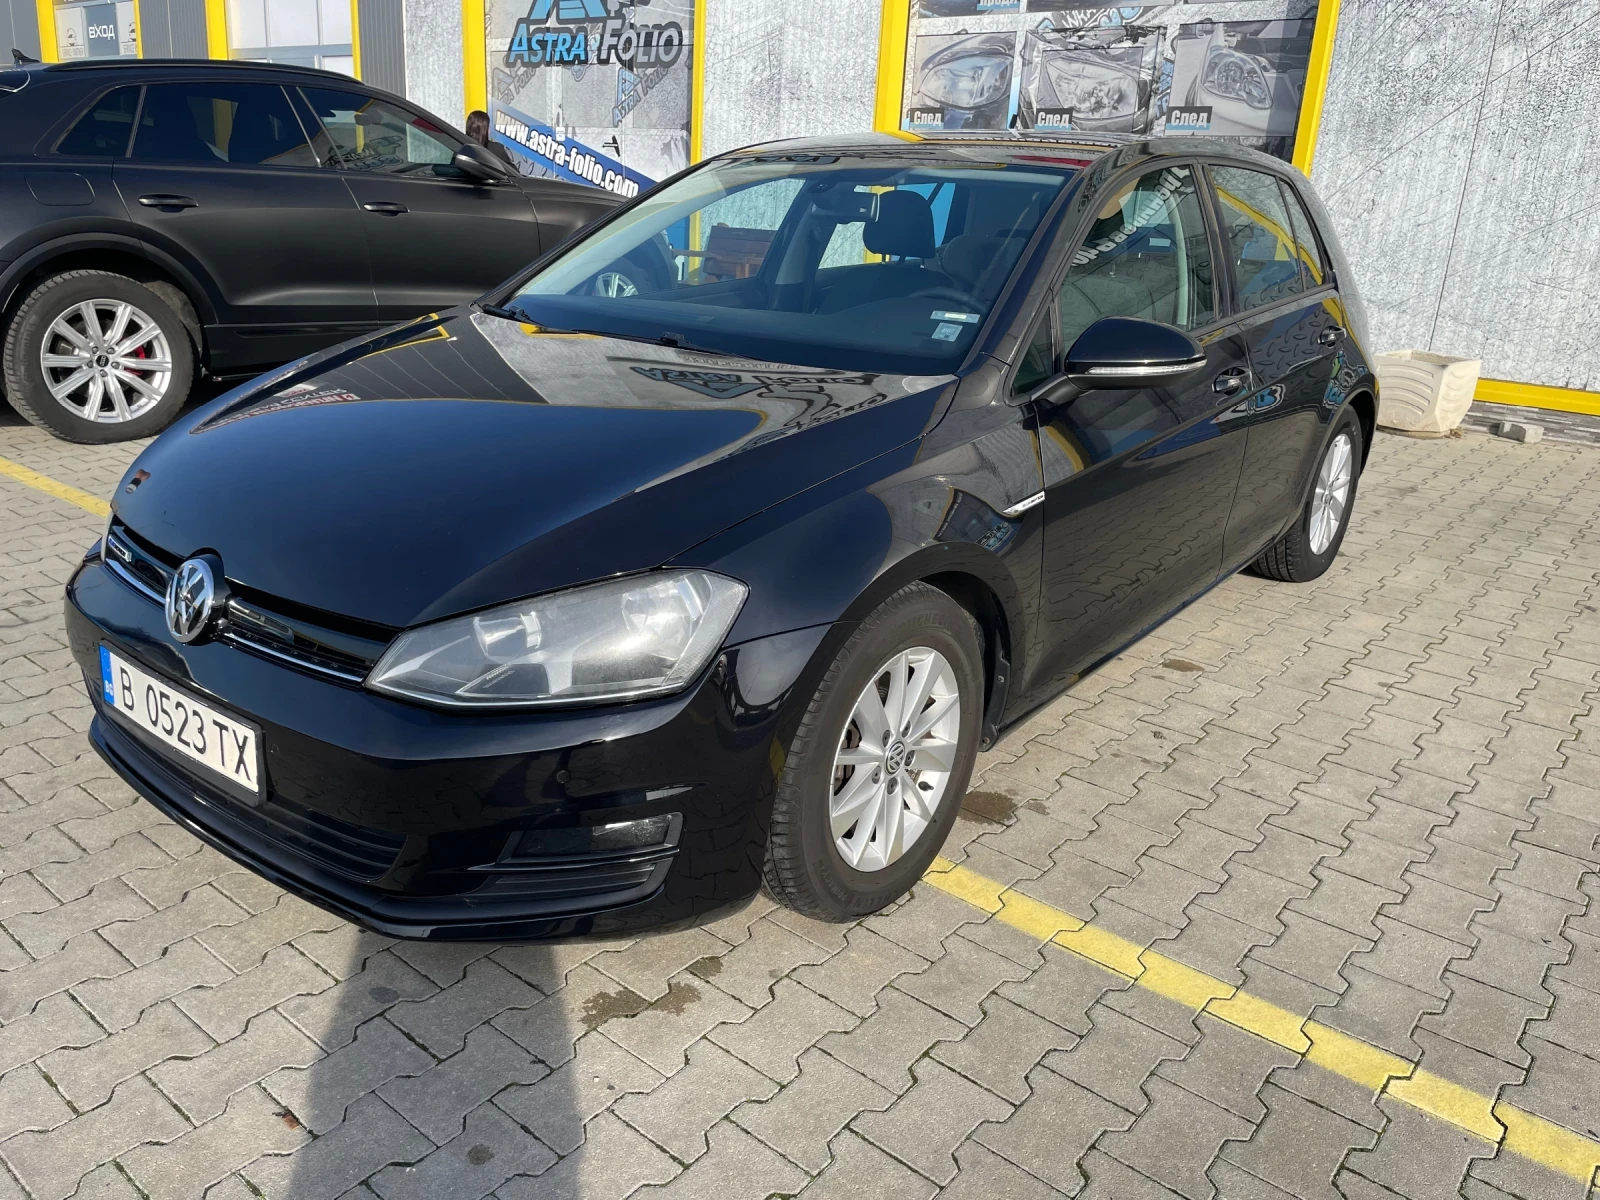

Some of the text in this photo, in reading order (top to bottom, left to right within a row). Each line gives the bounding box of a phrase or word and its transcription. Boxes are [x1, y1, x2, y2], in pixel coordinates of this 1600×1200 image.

[913, 111, 942, 127] След
[1037, 112, 1070, 128] След
[1171, 110, 1208, 128] След
[495, 110, 639, 198] www.astra-folio.com
[104, 679, 114, 696] BG
[120, 667, 254, 783] B 0523 TX
